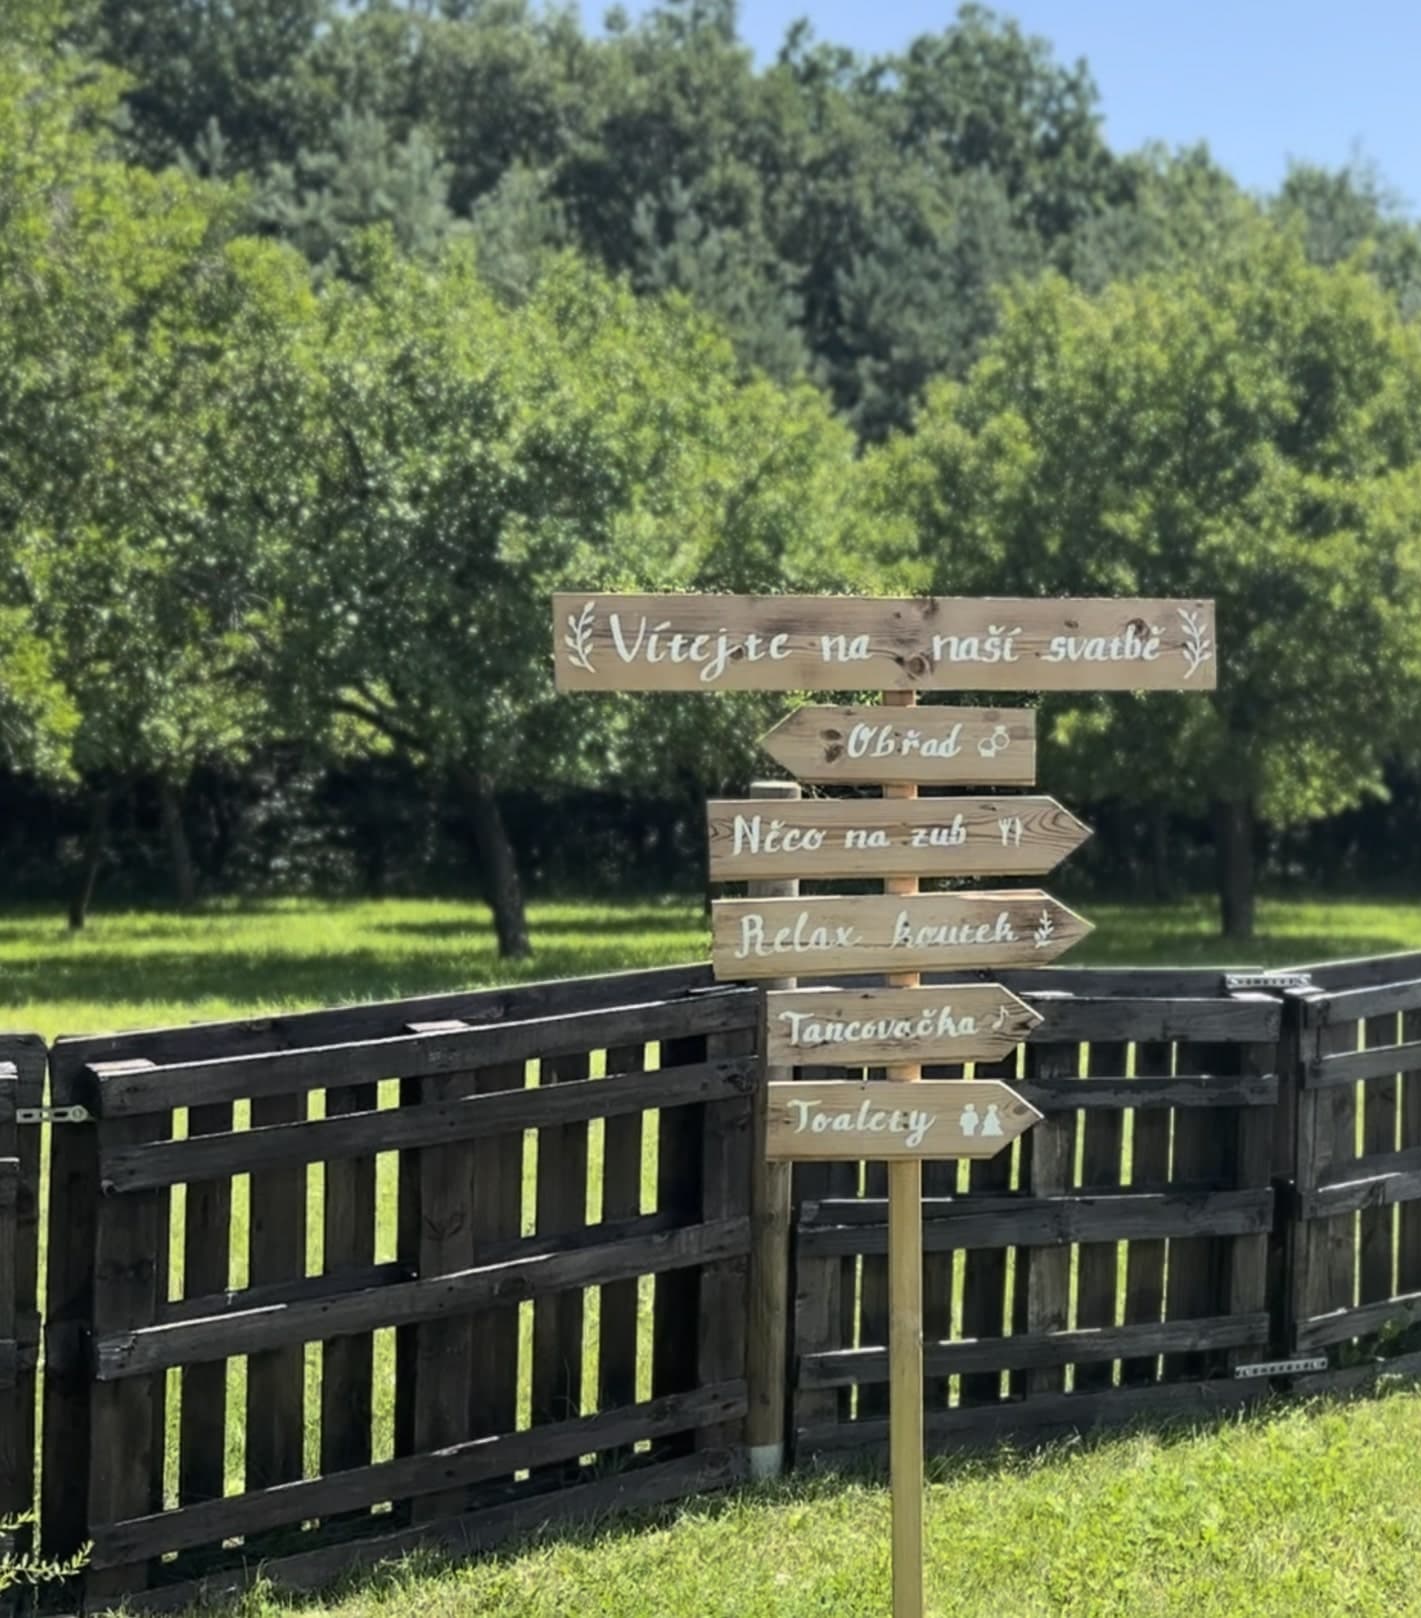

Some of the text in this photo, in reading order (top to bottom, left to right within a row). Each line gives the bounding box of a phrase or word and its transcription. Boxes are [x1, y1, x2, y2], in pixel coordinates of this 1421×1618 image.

[608, 613, 1167, 682] Vítejte na naší svatbě
[847, 723, 964, 758] Obřad
[844, 828, 891, 849] na
[911, 813, 968, 849] zub
[734, 909, 1019, 960] Relax koutek
[779, 1006, 979, 1045] Tancovačka
[786, 1098, 937, 1148] Toalety
